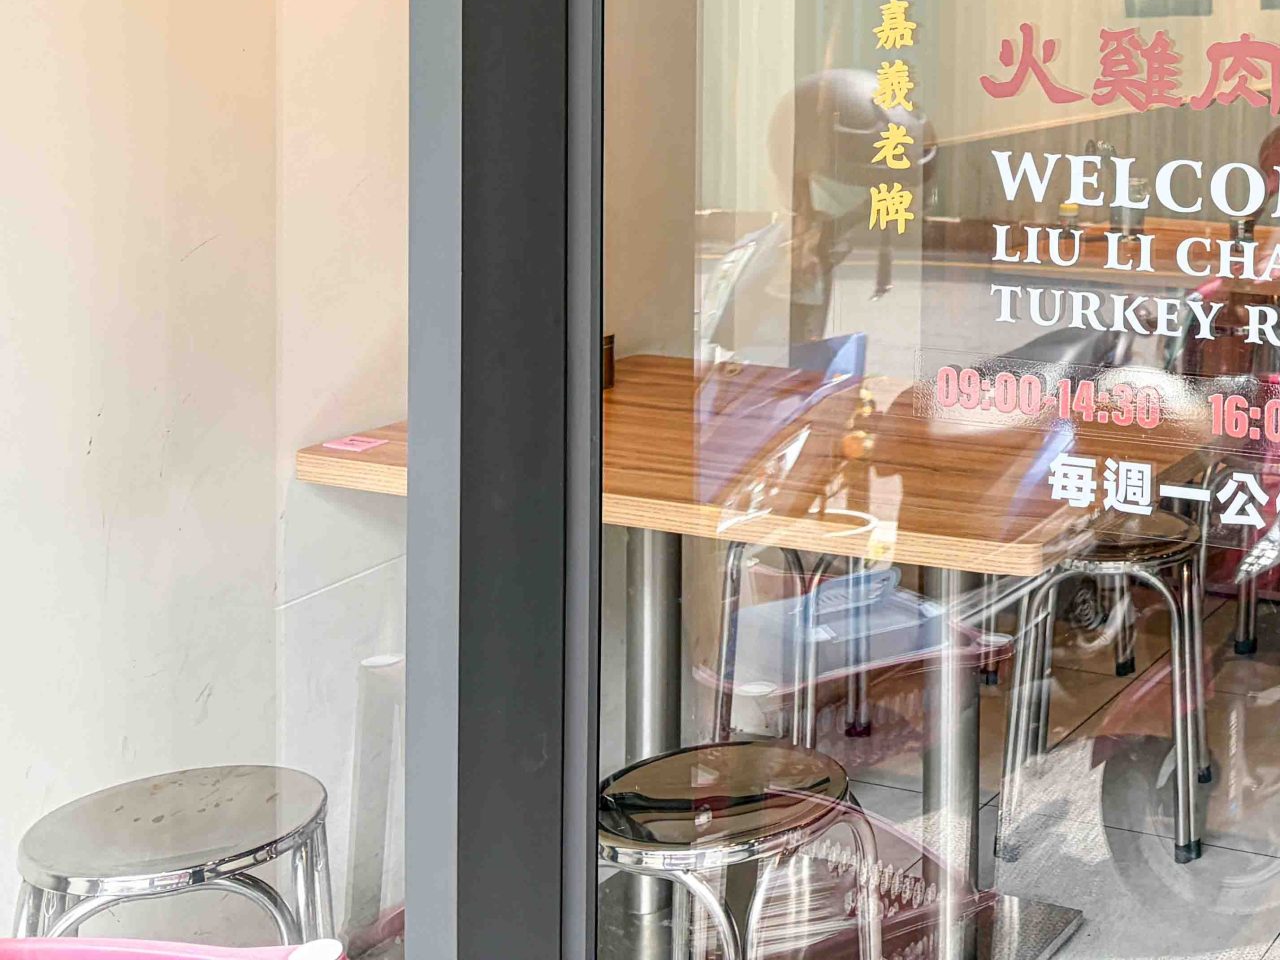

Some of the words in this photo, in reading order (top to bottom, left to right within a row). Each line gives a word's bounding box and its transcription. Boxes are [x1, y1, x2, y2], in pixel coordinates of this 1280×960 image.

[991, 224, 1084, 267] LIU
[1103, 231, 1156, 273] LI
[990, 284, 1225, 341] TURKEY
[936, 366, 1162, 429] 09:00-14:30
